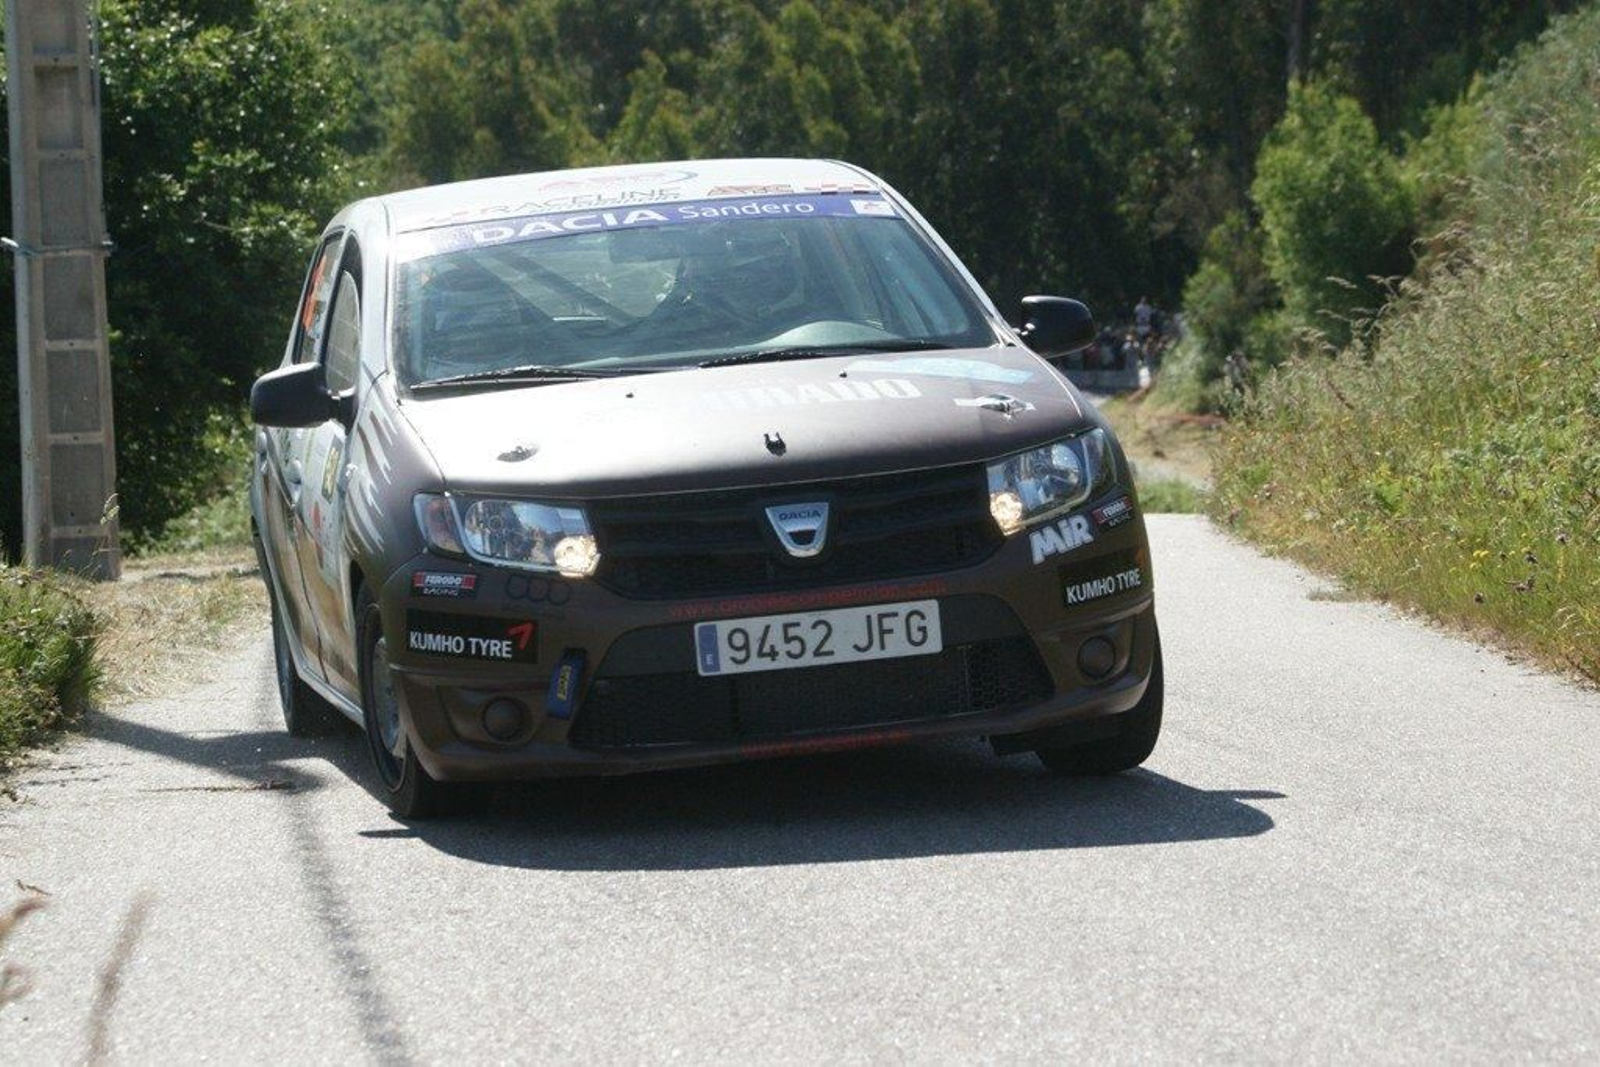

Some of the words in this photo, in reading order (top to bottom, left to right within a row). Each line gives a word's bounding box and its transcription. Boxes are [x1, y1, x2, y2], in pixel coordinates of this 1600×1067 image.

[472, 207, 669, 243] DACIA
[677, 199, 816, 220] Sandero
[778, 508, 822, 522] DACIA
[424, 574, 463, 587] FERODO
[1066, 578, 1115, 604] KUMHO
[1116, 569, 1141, 589] TYRE
[409, 630, 465, 654] KUMHO
[467, 636, 513, 659] TYRE
[726, 618, 836, 666] 9452
[852, 608, 929, 655] JFG
[706, 654, 714, 666] E
